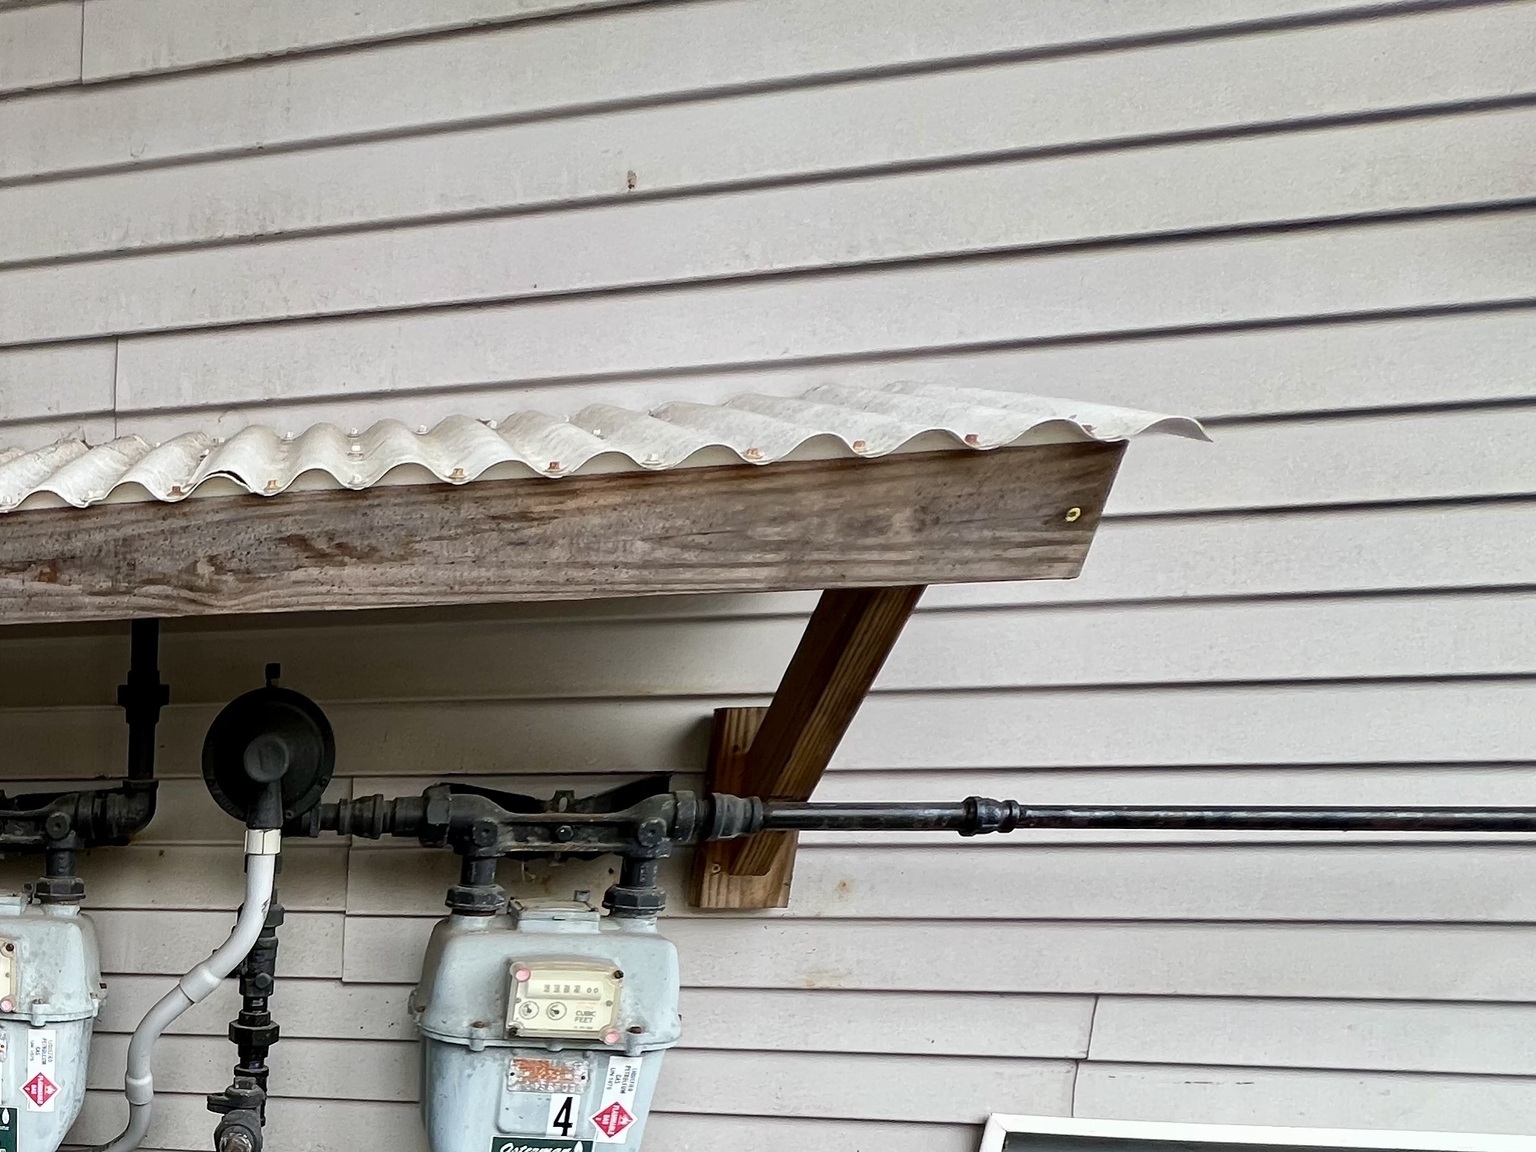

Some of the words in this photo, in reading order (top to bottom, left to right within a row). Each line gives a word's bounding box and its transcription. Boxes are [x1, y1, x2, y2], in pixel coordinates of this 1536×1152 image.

[609, 1067, 616, 1076] UN
[614, 1074, 622, 1084] GAS
[620, 1065, 631, 1094] PETROLEUM
[553, 1096, 573, 1136] 4
[602, 1114, 610, 1125] GAS
[607, 1104, 620, 1135] FLAMMABLE
